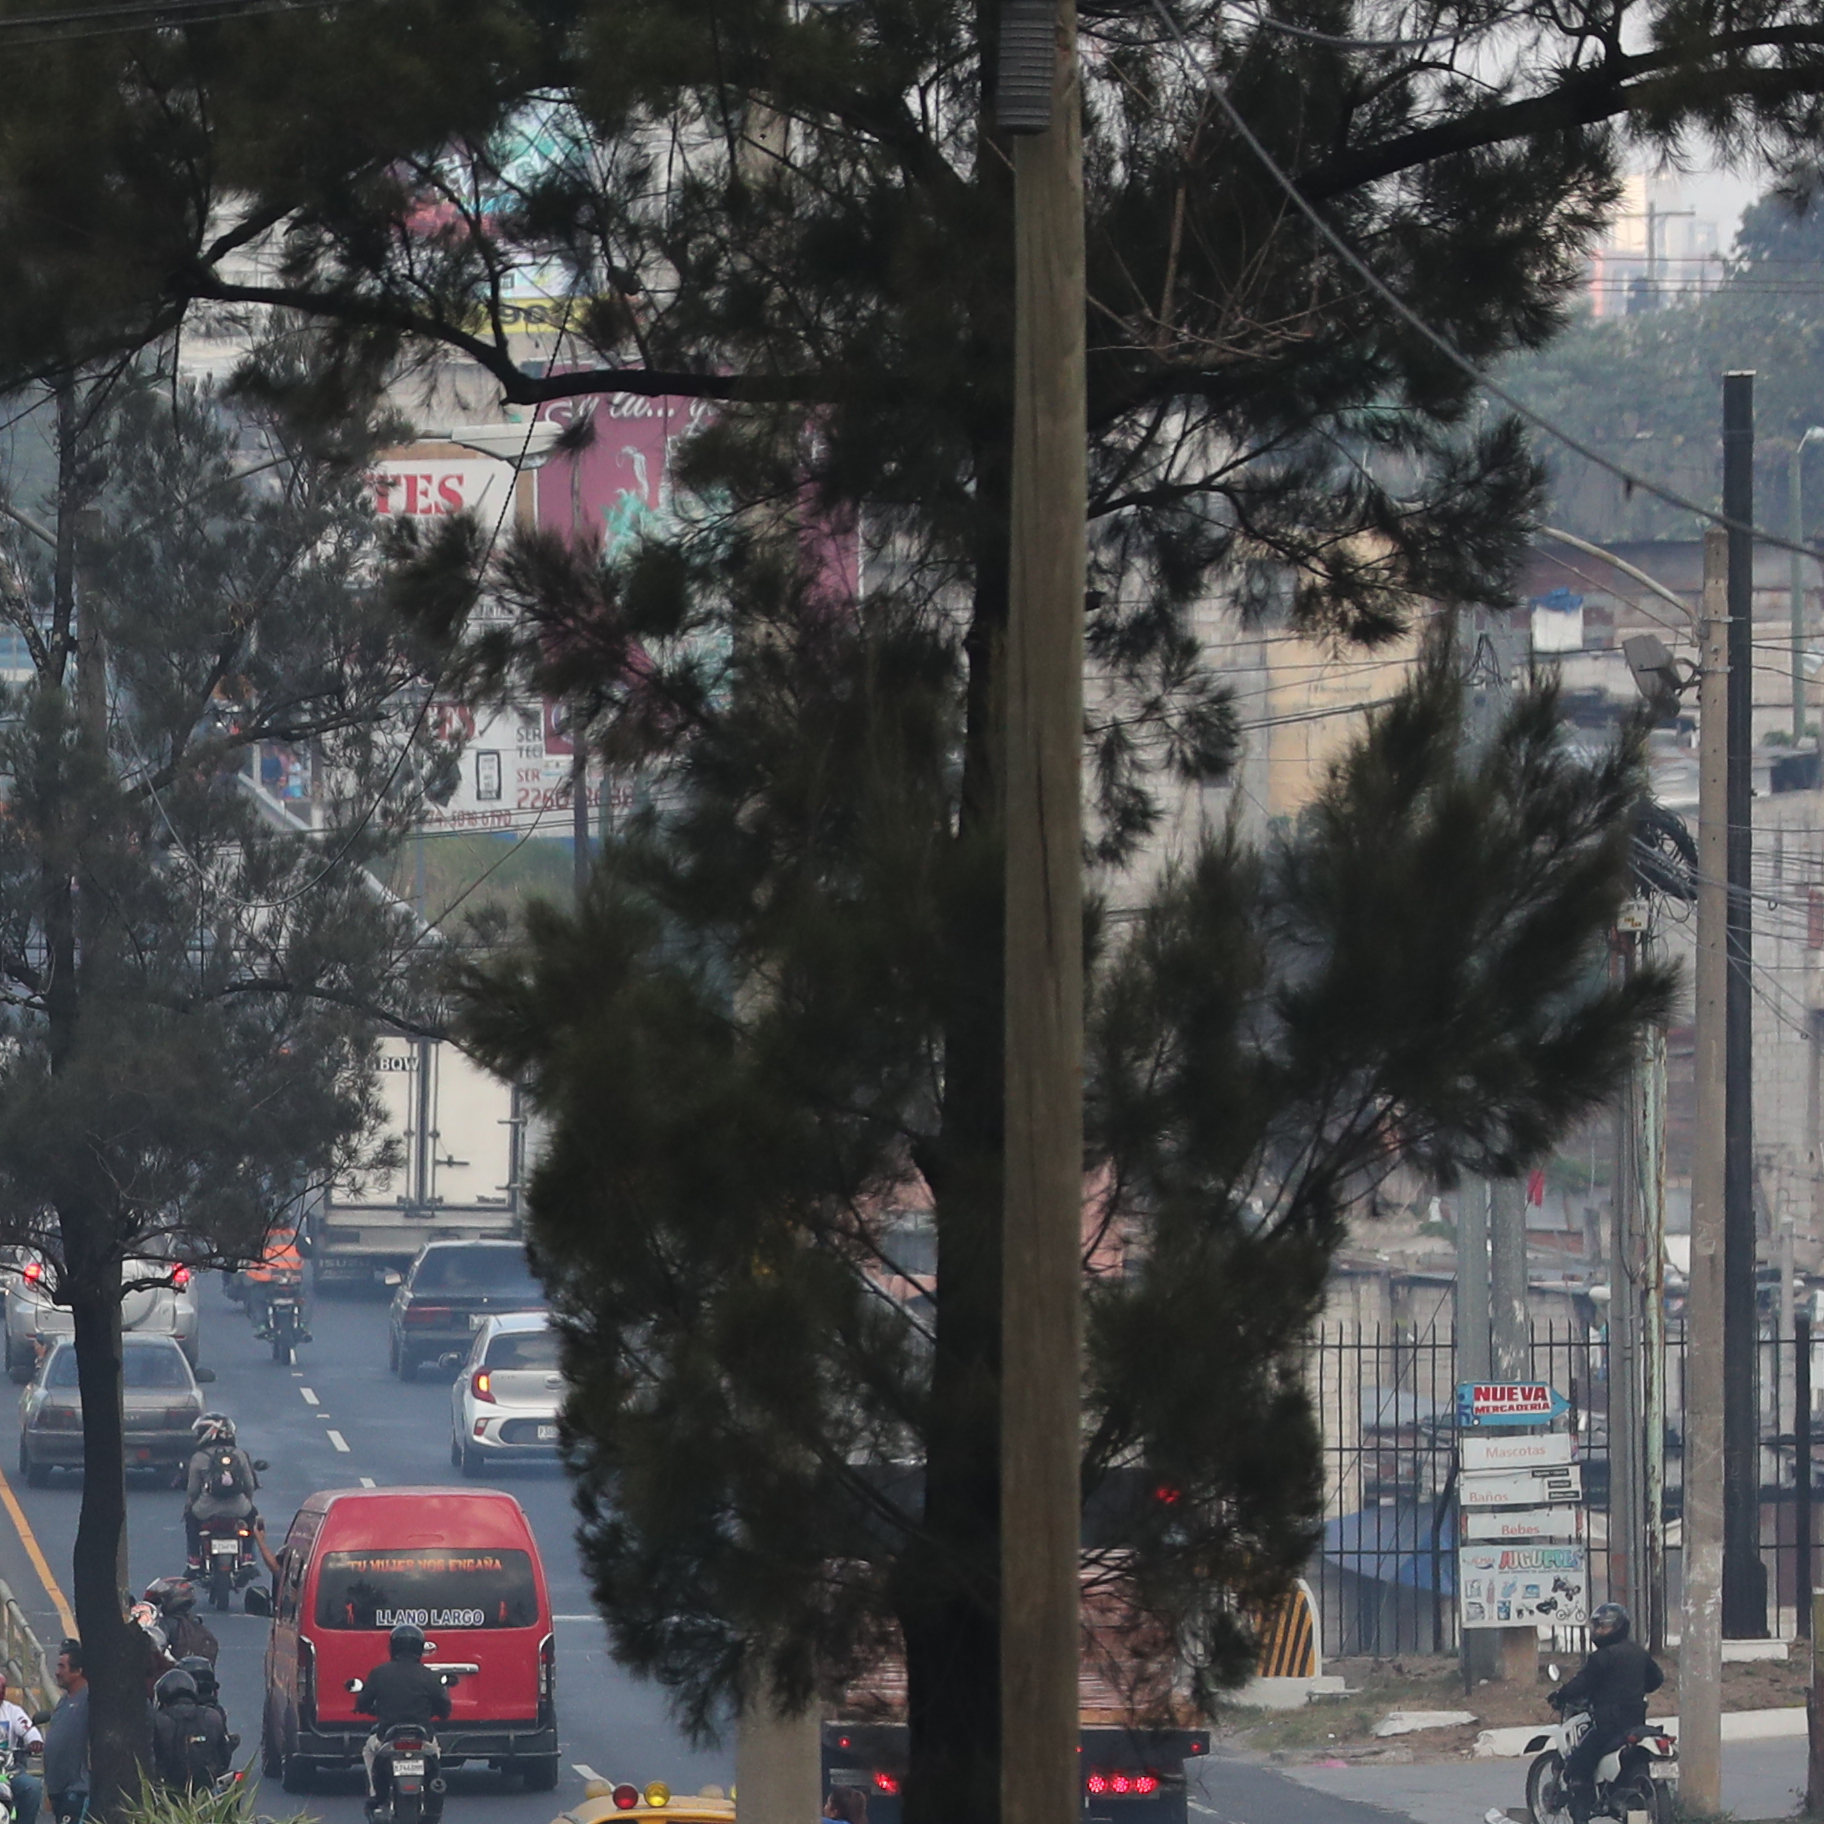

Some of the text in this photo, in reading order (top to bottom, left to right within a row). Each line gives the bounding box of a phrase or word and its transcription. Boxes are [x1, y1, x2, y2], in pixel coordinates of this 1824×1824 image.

[1473, 1386, 1548, 1402] NUEVA
[1485, 1445, 1546, 1459] Mascotas
[1469, 1490, 1509, 1503] Baños
[1501, 1523, 1540, 1536] Bebes
[349, 1559, 367, 1573] TU
[370, 1558, 415, 1573] MUJER
[376, 1608, 485, 1626] LLANO LARGO
